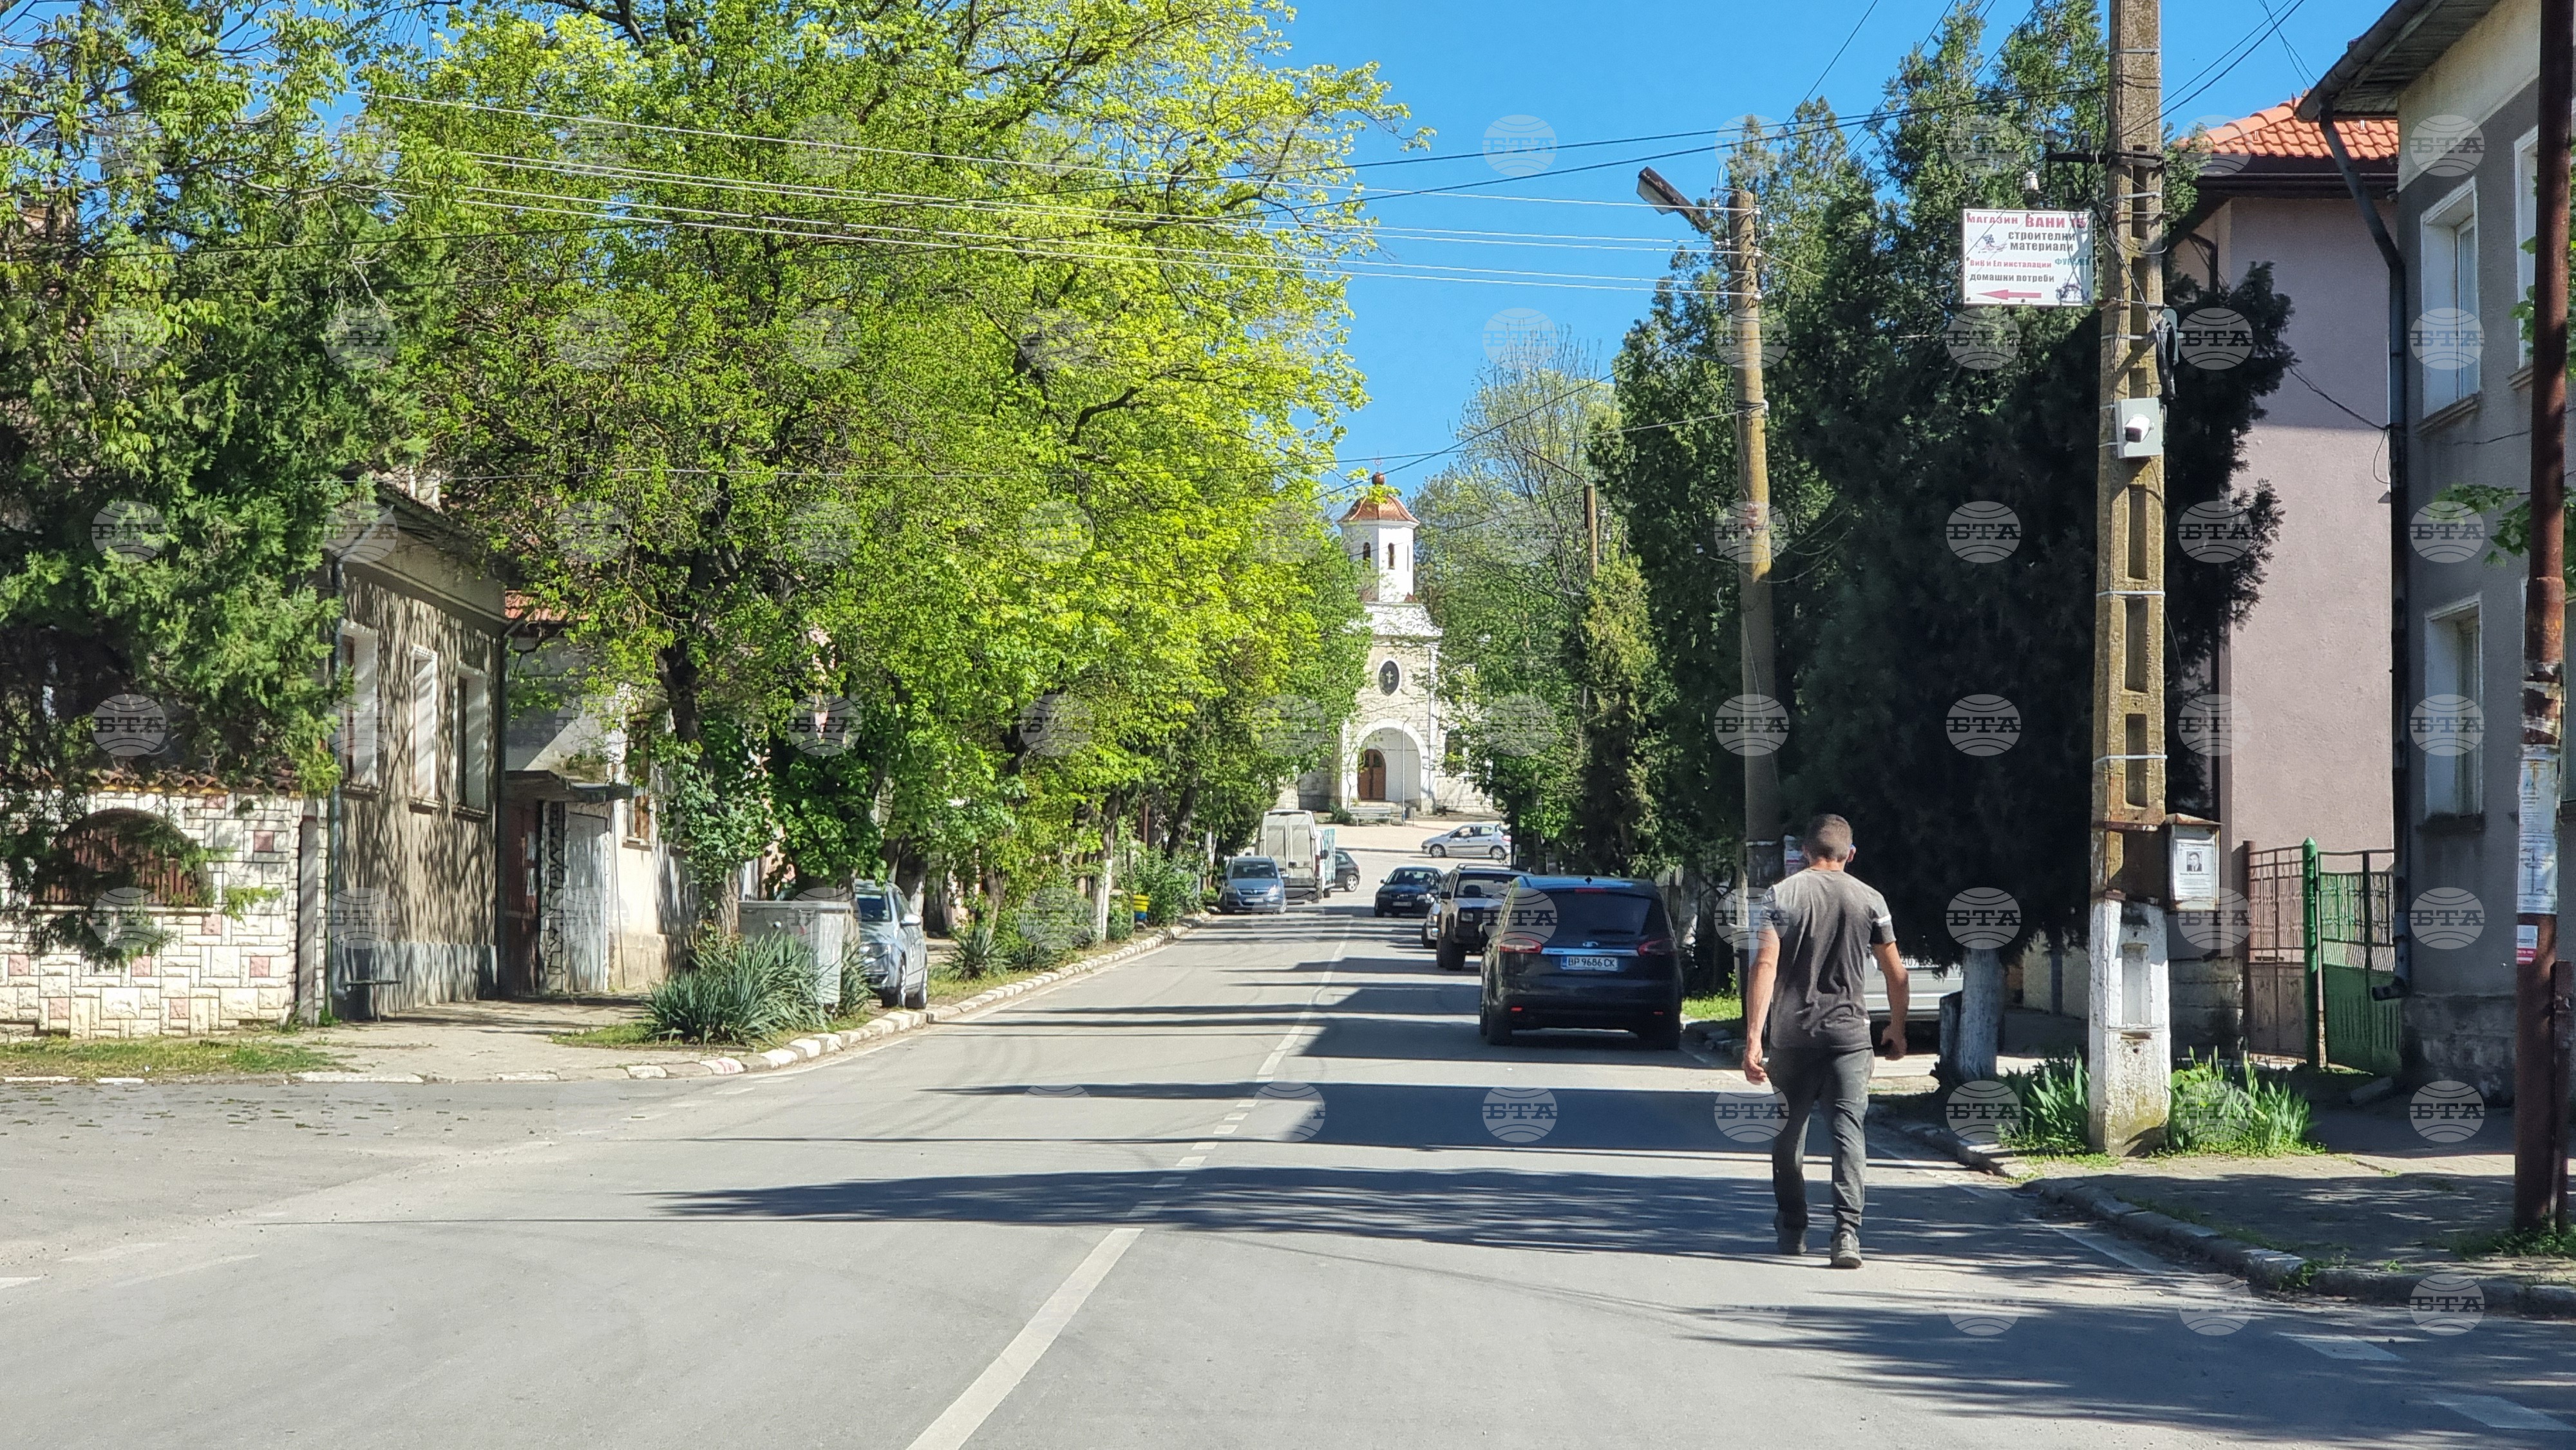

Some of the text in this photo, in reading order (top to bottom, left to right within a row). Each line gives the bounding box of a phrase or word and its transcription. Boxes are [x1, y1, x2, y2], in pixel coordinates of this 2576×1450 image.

[2025, 215, 2065, 228] ВАНИ
[2008, 231, 2076, 241] строителни
[2010, 242, 2074, 252] материали
[2003, 261, 2052, 269] инсталации
[2016, 274, 2054, 283] потреби
[1581, 957, 1603, 967] 9686
[1604, 958, 1615, 967] CK
